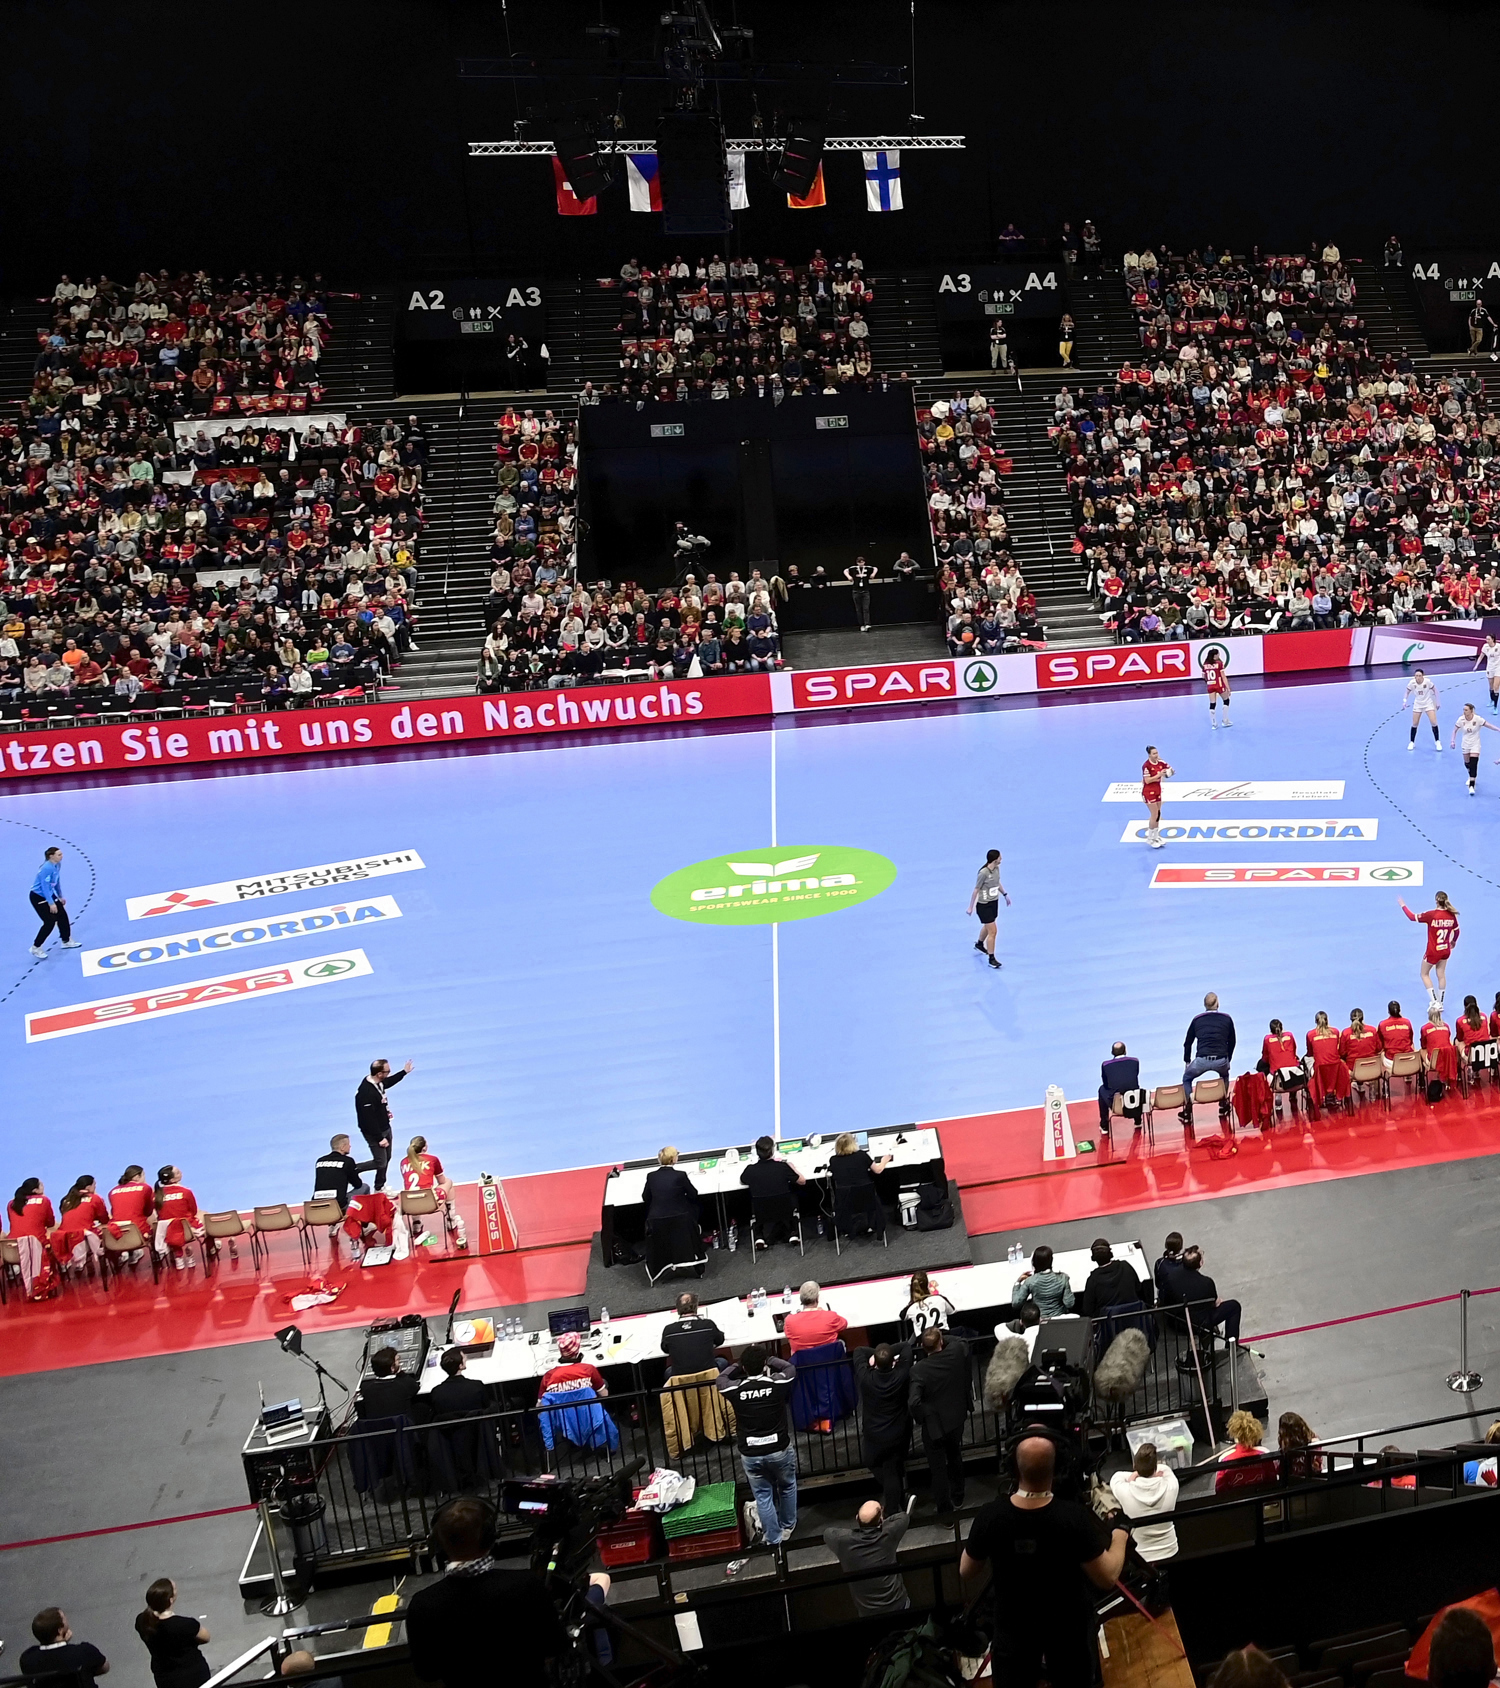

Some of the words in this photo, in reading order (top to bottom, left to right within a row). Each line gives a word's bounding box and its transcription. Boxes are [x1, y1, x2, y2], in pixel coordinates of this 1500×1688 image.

[938, 274, 972, 293] A3
[1024, 272, 1057, 291] A4
[1412, 263, 1440, 280] A4
[408, 290, 446, 311] A2
[505, 287, 542, 307] A3
[1048, 649, 1187, 682] SPAR
[1206, 670, 1216, 680] 10
[805, 667, 952, 702] SPAR
[121, 726, 189, 761] Sie
[208, 718, 283, 754] mit
[300, 717, 373, 746] uns
[390, 706, 464, 739] den
[482, 685, 704, 731] Nachwuchs
[235, 854, 412, 893] MITSUBISHI
[238, 870, 370, 900] MOTORS
[1203, 868, 1357, 881] SPAR
[690, 873, 860, 901] erima
[689, 897, 779, 912] SPORTSWEAR
[783, 892, 822, 902] SINCE
[825, 888, 858, 897] 1900
[97, 904, 387, 969] CONCORDIA
[93, 972, 290, 1020] SPAR
[1054, 1112, 1062, 1147] SPAR
[316, 1160, 345, 1169] SUISSE
[111, 1185, 143, 1195] SUISSE
[408, 1172, 419, 1190] 2
[490, 1202, 500, 1240] SPAR
[916, 1307, 944, 1333] 22
[739, 1387, 773, 1401] STAFF
